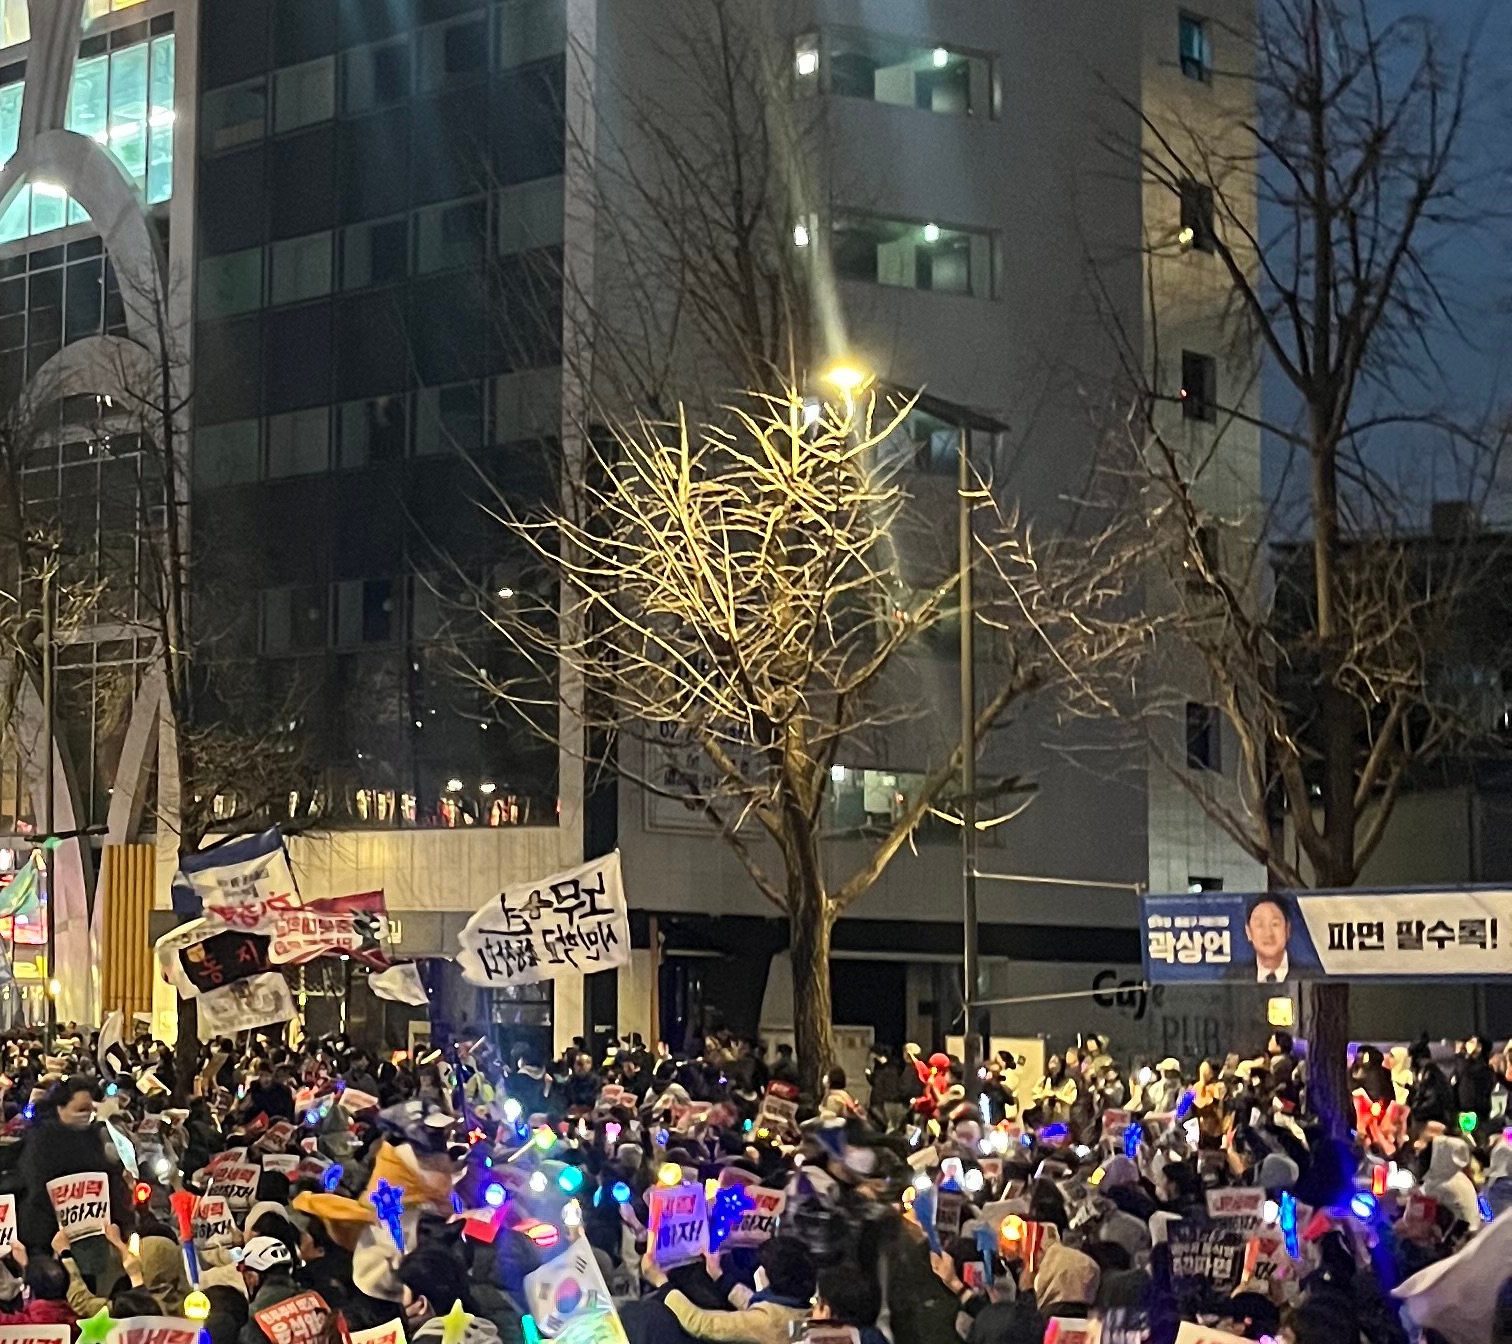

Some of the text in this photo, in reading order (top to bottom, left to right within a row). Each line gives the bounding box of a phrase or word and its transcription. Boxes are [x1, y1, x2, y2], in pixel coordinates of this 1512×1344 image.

[1148, 930, 1232, 964] 곽상언
[1328, 920, 1385, 951] 파면
[51, 1179, 104, 1205] 란세력
[58, 1200, 107, 1227] 압하자!
[657, 1219, 704, 1250] 하자!
